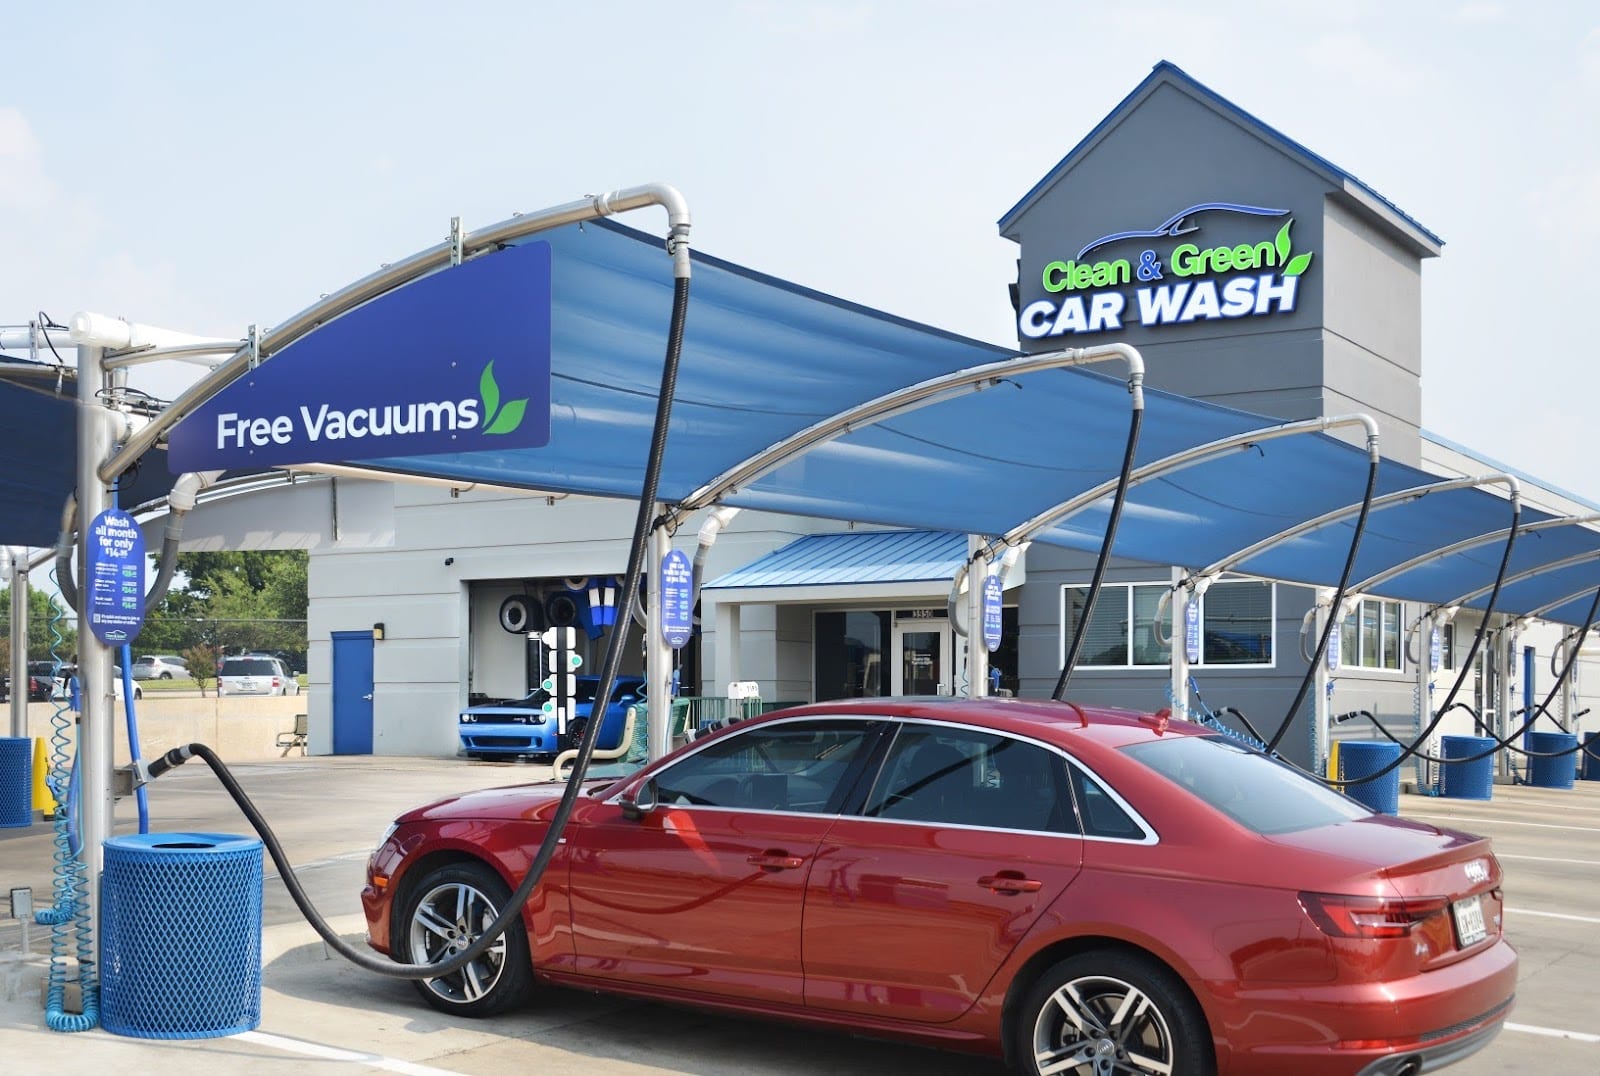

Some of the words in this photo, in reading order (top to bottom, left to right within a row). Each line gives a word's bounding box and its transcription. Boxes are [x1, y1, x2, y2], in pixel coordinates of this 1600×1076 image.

[1042, 259, 1130, 293] Clean
[1137, 250, 1164, 281] &
[1171, 241, 1276, 277] Green
[1019, 291, 1125, 339] CAR
[1136, 272, 1300, 326] WASH
[217, 412, 293, 450] Free
[300, 398, 480, 442] Vacuums
[95, 525, 107, 536] all
[107, 528, 138, 539] month
[104, 515, 130, 528] Wash
[99, 535, 113, 546] for
[114, 538, 134, 551] only
